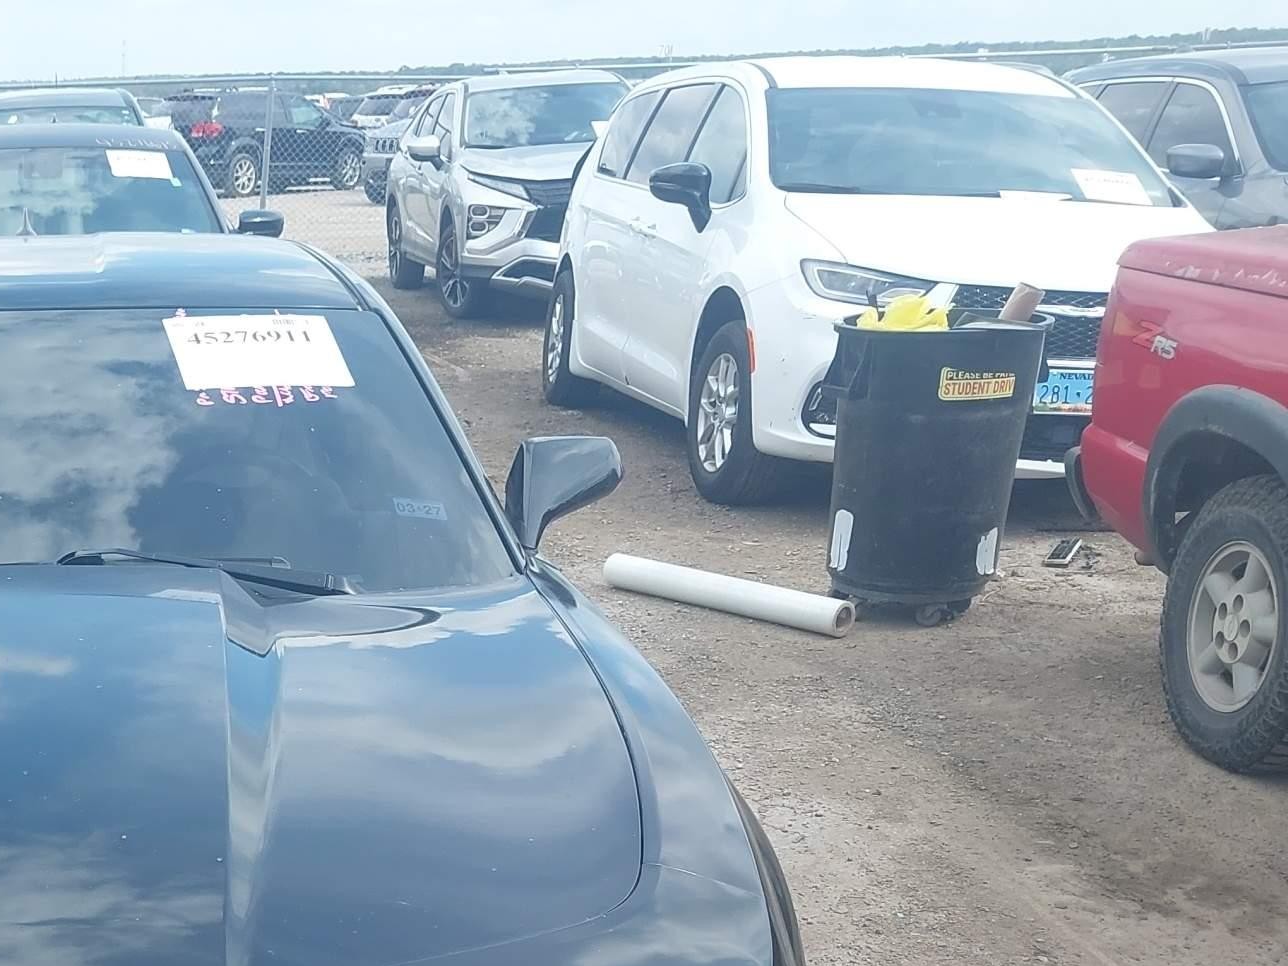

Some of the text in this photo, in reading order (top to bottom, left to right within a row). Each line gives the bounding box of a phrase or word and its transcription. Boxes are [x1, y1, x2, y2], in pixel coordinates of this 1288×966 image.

[187, 330, 311, 345] 45276911
[947, 371, 981, 380] PLEASE
[944, 382, 992, 395] STUDENT
[1039, 384, 1070, 404] 281
